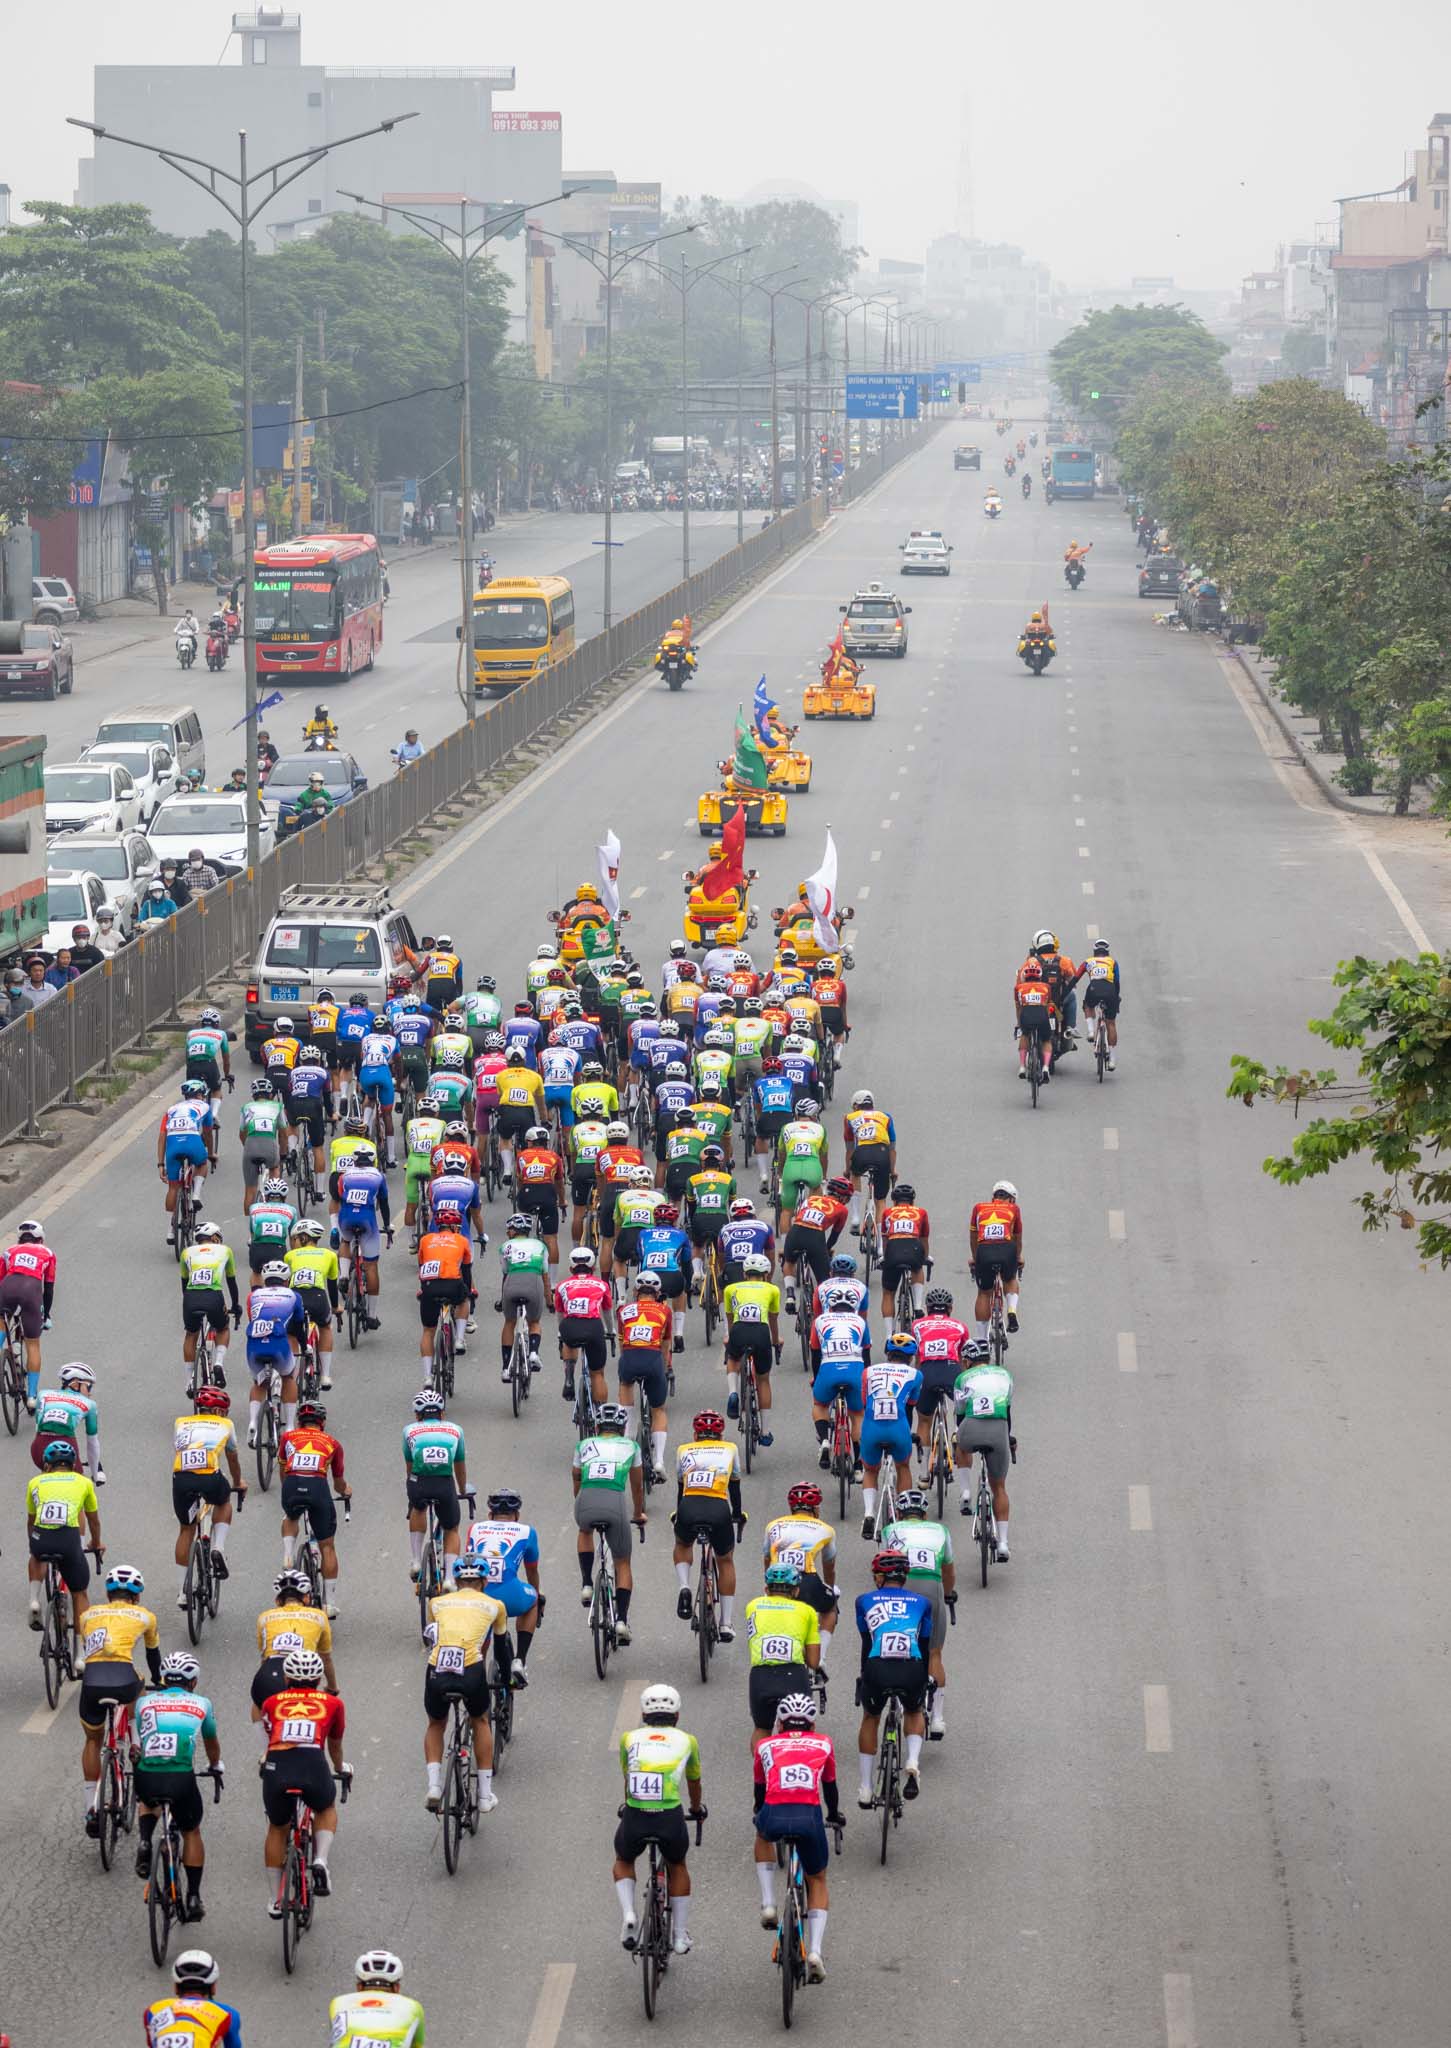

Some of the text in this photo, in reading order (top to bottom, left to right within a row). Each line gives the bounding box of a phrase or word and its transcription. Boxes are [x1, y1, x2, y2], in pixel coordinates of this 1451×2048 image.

[493, 120, 558, 130] 0912 093 390
[402, 1032, 416, 1040] 97
[553, 1070, 566, 1078] 12
[433, 1091, 446, 1099] 27
[511, 1091, 527, 1100] 107
[172, 1118, 186, 1127] 13
[262, 1120, 268, 1128] 4
[698, 1122, 714, 1132] 47
[415, 1141, 431, 1150] 146
[584, 1148, 598, 1156] 54
[339, 1158, 354, 1167] 62
[350, 1192, 367, 1200] 102
[703, 1196, 718, 1204] 44
[632, 1211, 648, 1220] 52
[805, 1210, 823, 1222] 117
[265, 1224, 280, 1232] 21
[986, 1226, 1003, 1236] 123
[734, 1244, 750, 1254] 93
[18, 1254, 35, 1266] 86
[650, 1254, 666, 1264] 73
[422, 1262, 438, 1273] 156
[193, 1272, 211, 1282] 145
[296, 1271, 313, 1281] 64
[569, 1300, 586, 1310] 84
[741, 1307, 758, 1318] 67
[632, 1326, 651, 1338] 127
[832, 1340, 848, 1351] 16
[928, 1342, 945, 1352] 82
[878, 1402, 896, 1414] 11
[980, 1397, 990, 1410] 2
[183, 1451, 206, 1465] 153
[426, 1448, 446, 1459] 26
[296, 1456, 317, 1466] 121
[597, 1464, 607, 1474] 5
[689, 1472, 711, 1483] 151
[45, 1505, 64, 1519] 61
[782, 1552, 804, 1566] 152
[917, 1550, 927, 1562] 6
[278, 1634, 300, 1646] 132
[886, 1636, 908, 1652] 75
[766, 1640, 788, 1654] 63
[440, 1650, 462, 1668] 135
[287, 1722, 312, 1737] 111
[149, 1736, 174, 1750] 23
[785, 1767, 810, 1782] 85
[632, 1776, 660, 1794] 144
